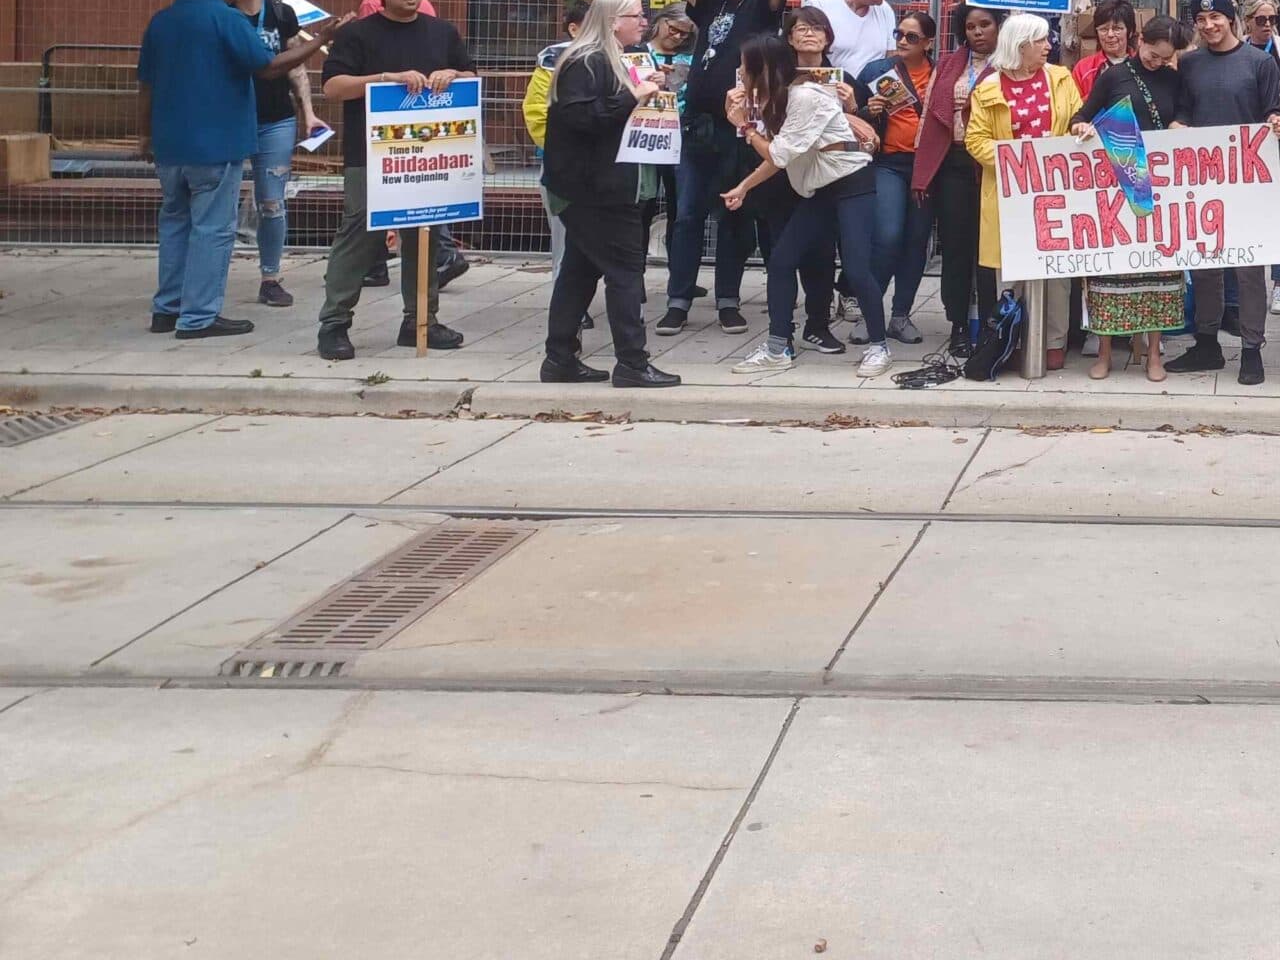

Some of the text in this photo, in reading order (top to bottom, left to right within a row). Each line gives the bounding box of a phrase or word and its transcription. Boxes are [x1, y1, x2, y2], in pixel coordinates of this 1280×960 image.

[389, 145, 424, 155] Time for
[627, 130, 672, 151] Wages!
[382, 154, 474, 174] Biidaaban:
[997, 125, 1272, 197] MnaaenmiK
[382, 172, 449, 185] New Beginning
[1129, 250, 1162, 269] OUR
